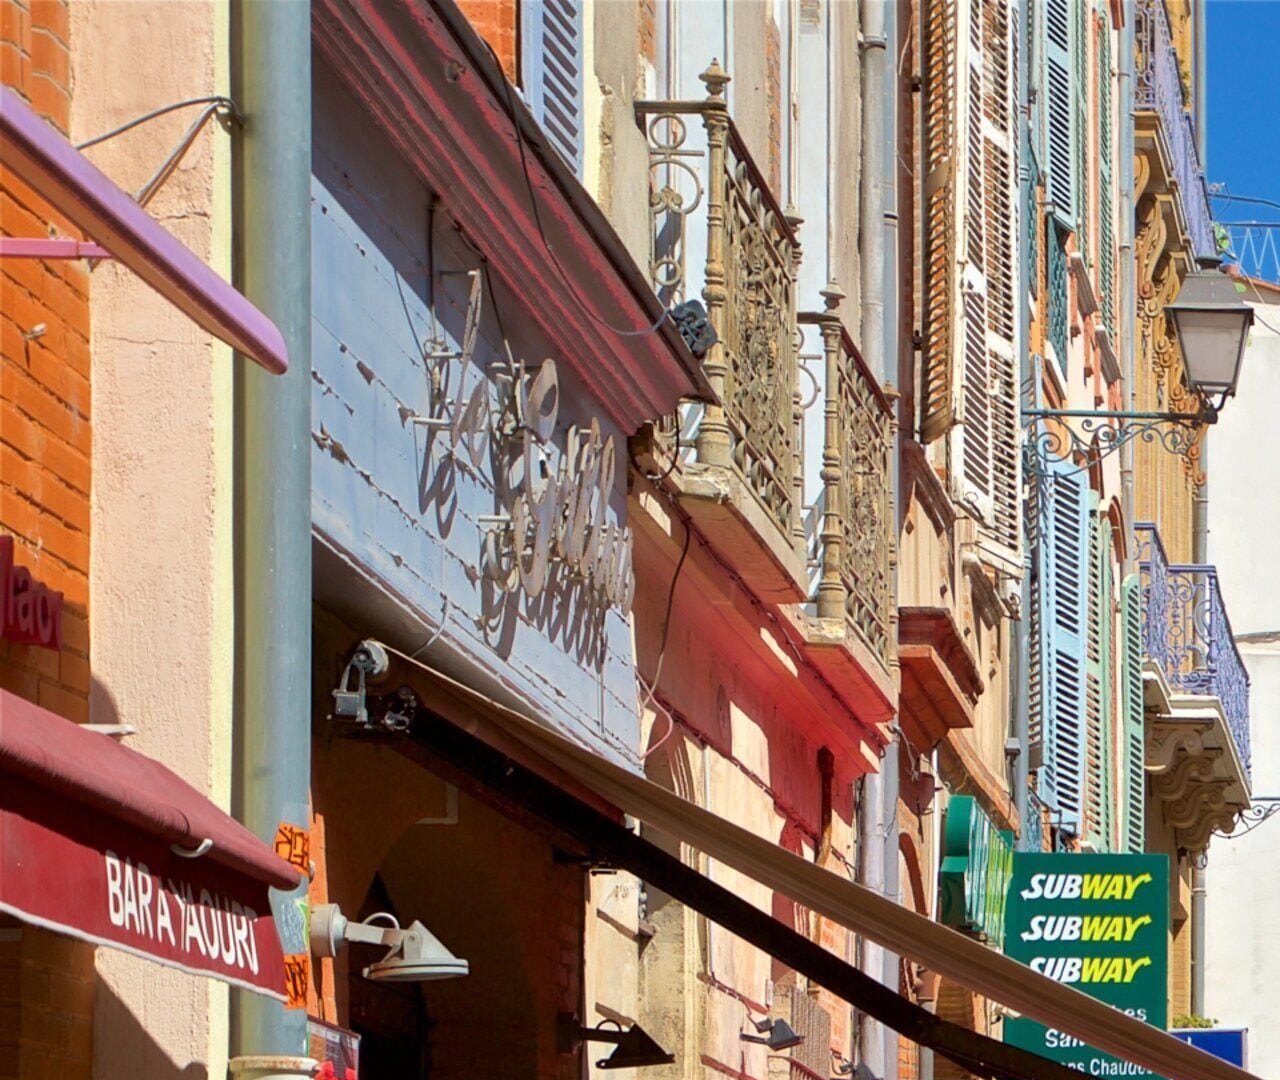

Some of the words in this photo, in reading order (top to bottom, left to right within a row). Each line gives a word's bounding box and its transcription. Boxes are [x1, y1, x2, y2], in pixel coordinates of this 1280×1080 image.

[1021, 872, 1152, 901] SUBWAY
[106, 850, 153, 940] BAR
[168, 879, 259, 976] YAOURT
[1021, 914, 1152, 942] SUBWAY
